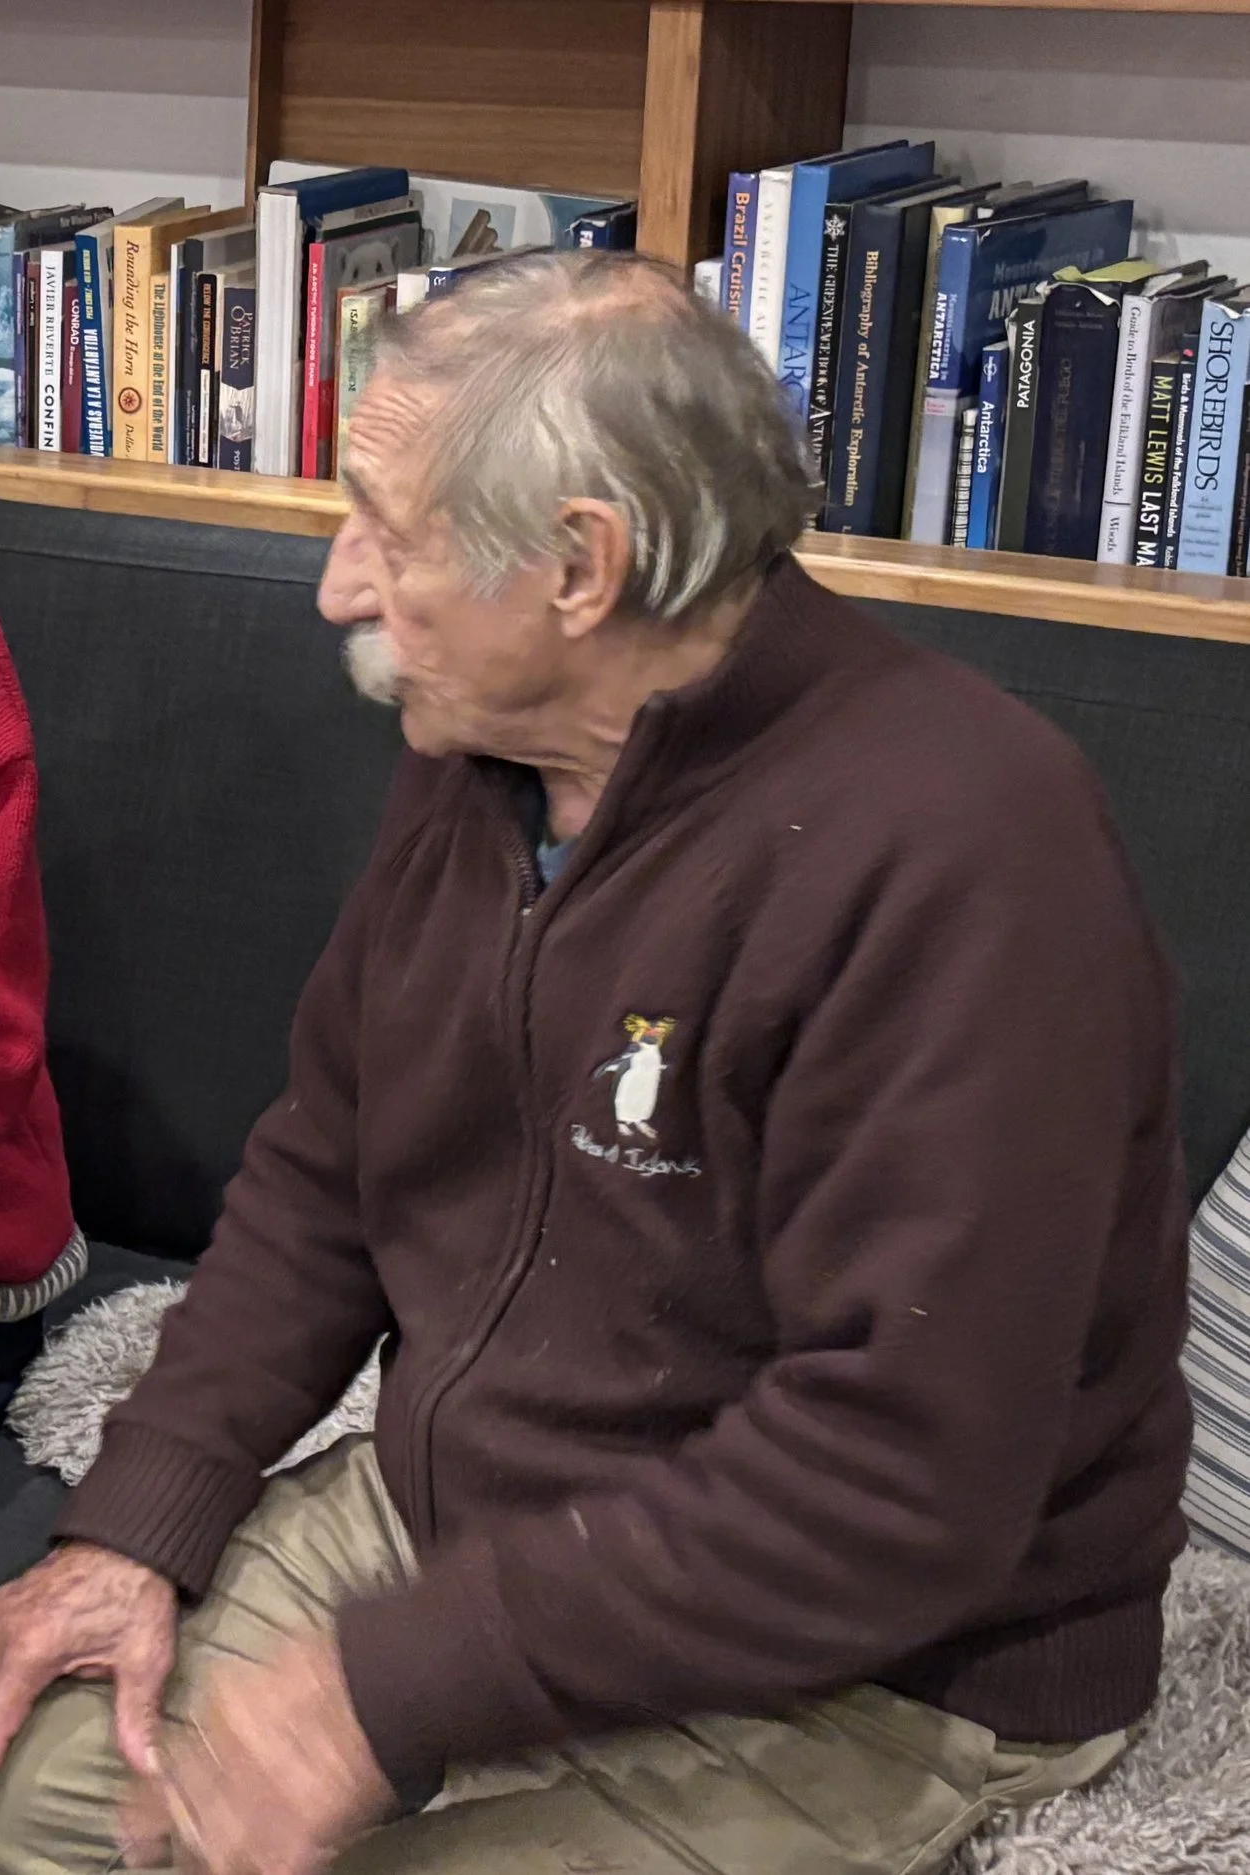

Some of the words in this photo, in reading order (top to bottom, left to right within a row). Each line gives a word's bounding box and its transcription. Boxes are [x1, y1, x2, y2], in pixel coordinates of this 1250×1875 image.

[732, 191, 750, 248] Brazil
[121, 239, 141, 310] Rounding
[826, 243, 841, 273] THE
[45, 265, 56, 313] JAVIER
[154, 283, 165, 301] The
[857, 250, 879, 339] Bibliography
[70, 298, 80, 346] CONRAD
[124, 311, 140, 335] the
[152, 301, 165, 351] Lighthouse
[229, 304, 246, 370] O'BRIAN
[239, 311, 253, 367] PATRICK
[928, 291, 948, 381] ANTARCTICA
[1128, 305, 1142, 340] Guide
[44, 316, 55, 377] REVERTE
[82, 328, 101, 386] ANTÁRTIDA
[124, 337, 139, 377] Horn
[152, 351, 164, 362] at
[857, 342, 870, 358] of
[1015, 318, 1036, 409] PATAGONIA
[1127, 339, 1138, 351] to
[152, 363, 165, 378] the
[1123, 352, 1138, 381] Birds
[1180, 372, 1192, 395] Birds
[86, 387, 101, 399] LA
[88, 400, 101, 409] A
[152, 379, 165, 397] End
[152, 398, 164, 409] of
[851, 362, 869, 425] Antarctic
[1120, 393, 1134, 412] the
[1123, 381, 1135, 393] of
[1151, 375, 1175, 424] MATT
[1180, 395, 1189, 403] &
[1193, 320, 1235, 491] SHOREBIRDS
[43, 383, 55, 448] CONFIN
[84, 410, 104, 457] VOLVERÁS
[152, 409, 164, 425] the
[1174, 404, 1189, 447] Mammals
[151, 425, 164, 453] World
[976, 400, 996, 475] Antarctica
[1116, 412, 1132, 459] Falkland
[1174, 446, 1185, 457] of
[843, 427, 864, 507] Exploration
[1143, 429, 1168, 485] LEWIS
[1173, 456, 1184, 470] the
[1112, 459, 1127, 497] Islands
[1168, 471, 1183, 508] Falkland
[1138, 490, 1162, 535] LAST
[1166, 508, 1179, 538] Islands
[1106, 516, 1120, 553] Woods
[1136, 540, 1157, 567] MA
